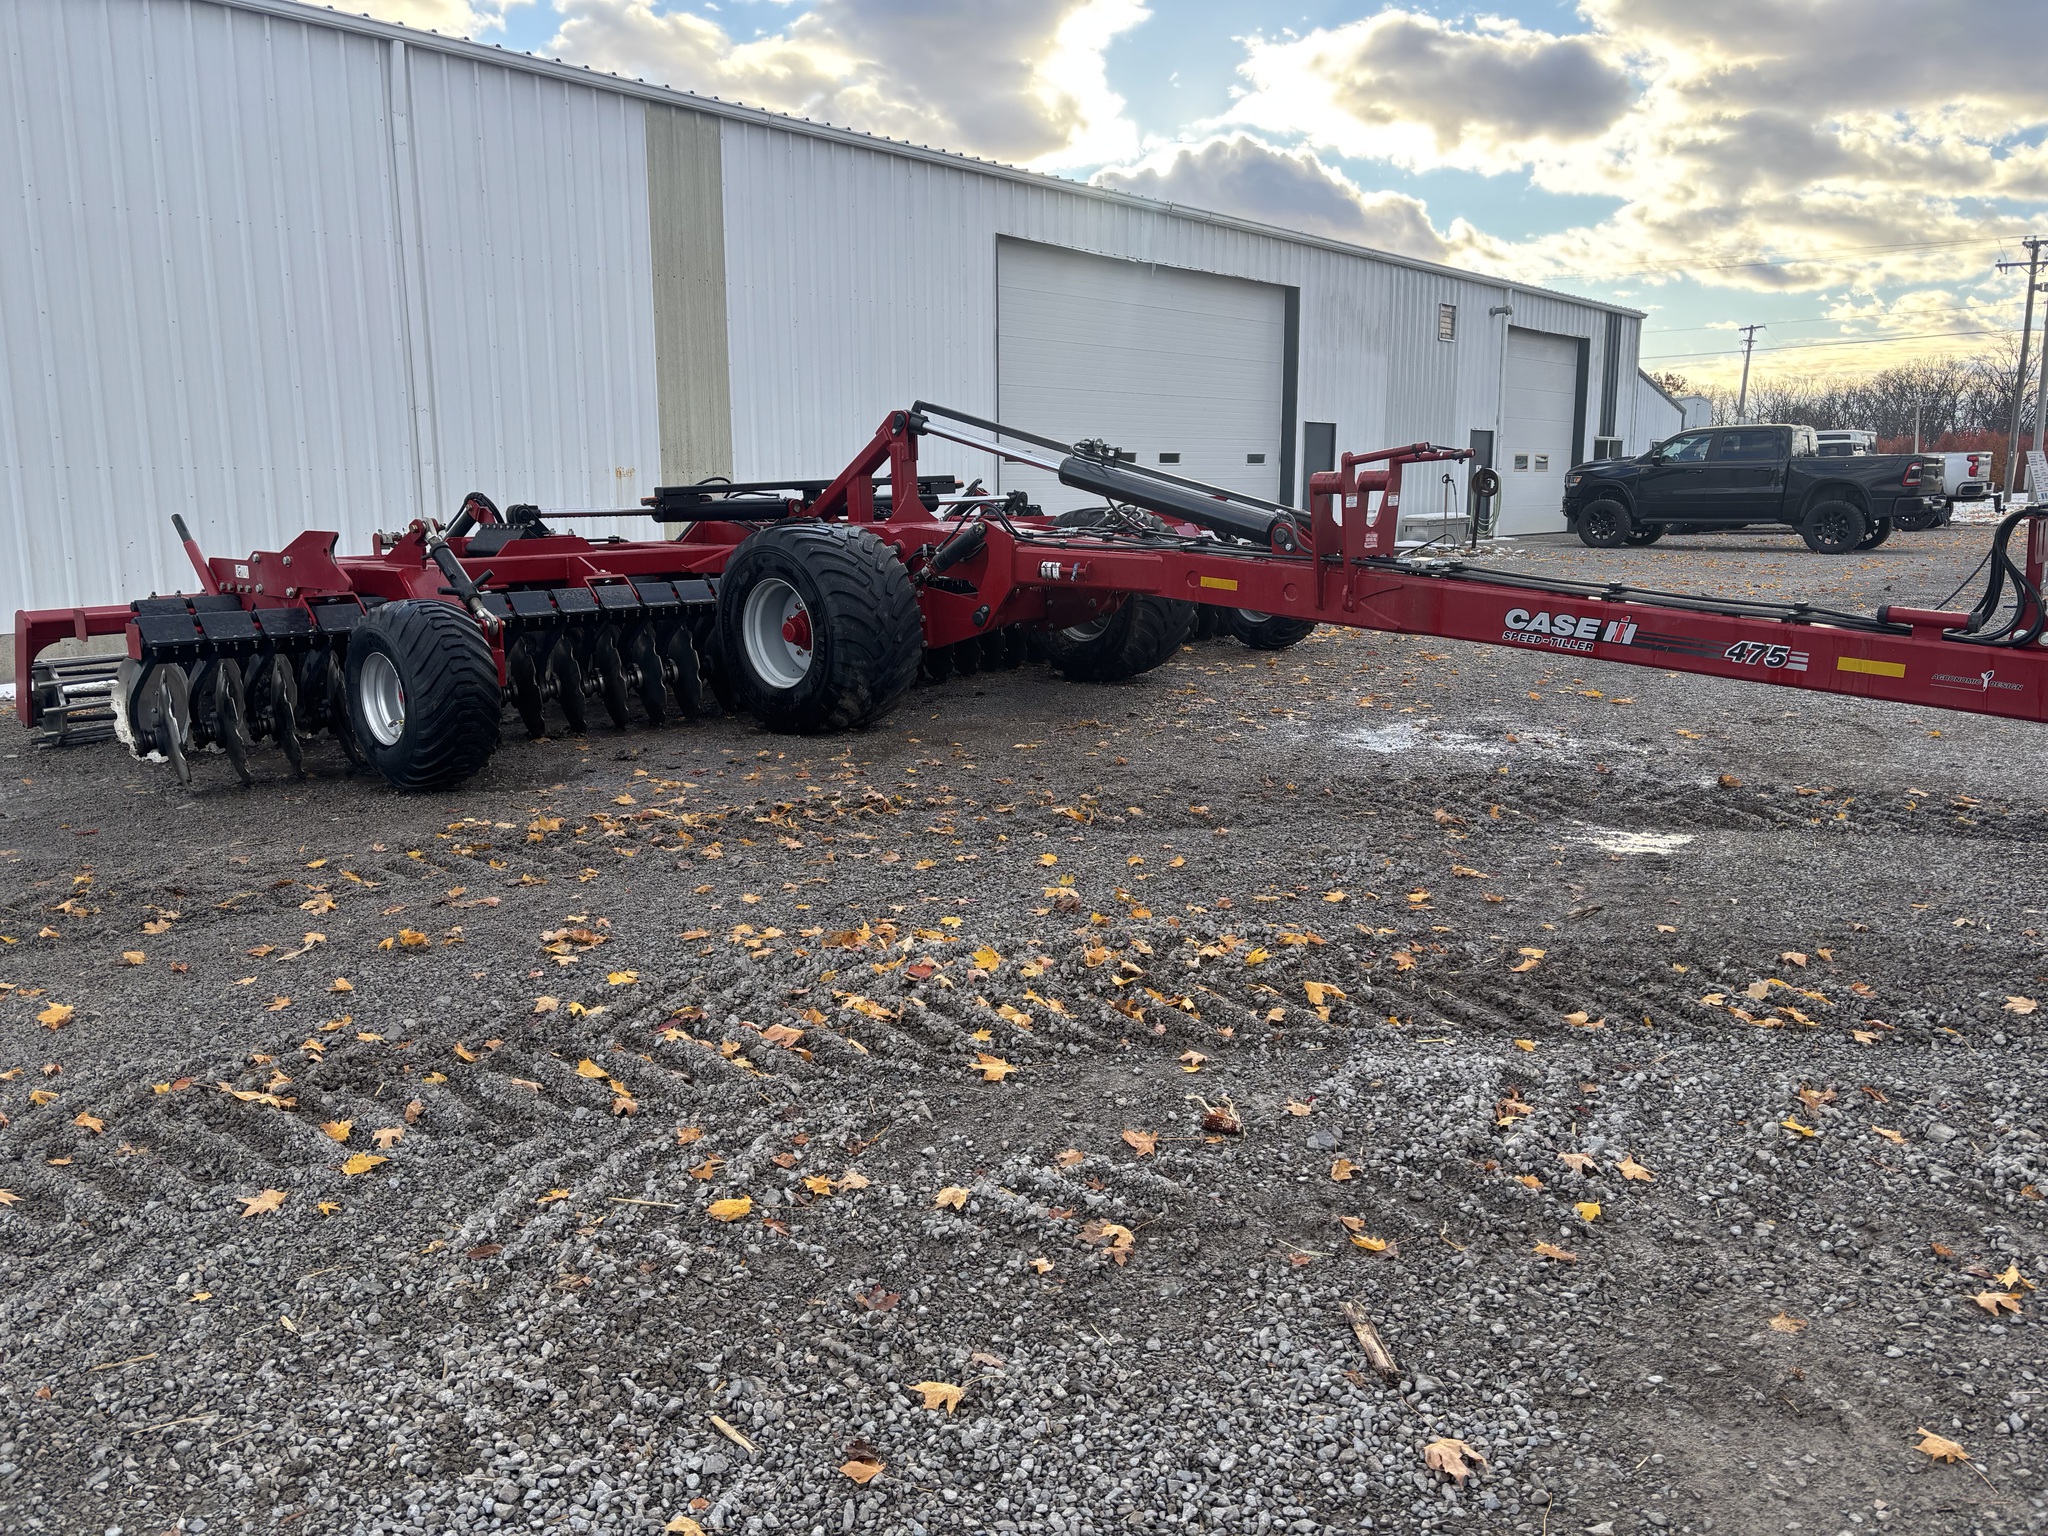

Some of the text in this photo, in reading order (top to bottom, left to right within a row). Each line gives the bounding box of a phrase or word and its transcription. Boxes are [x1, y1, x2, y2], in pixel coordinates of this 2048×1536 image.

[1504, 608, 1602, 640] CASE
[1502, 631, 1595, 652] SPEED-TILLER
[1723, 640, 1792, 669] 475
[1931, 674, 2023, 691] AGRONOMIC DESIGN
